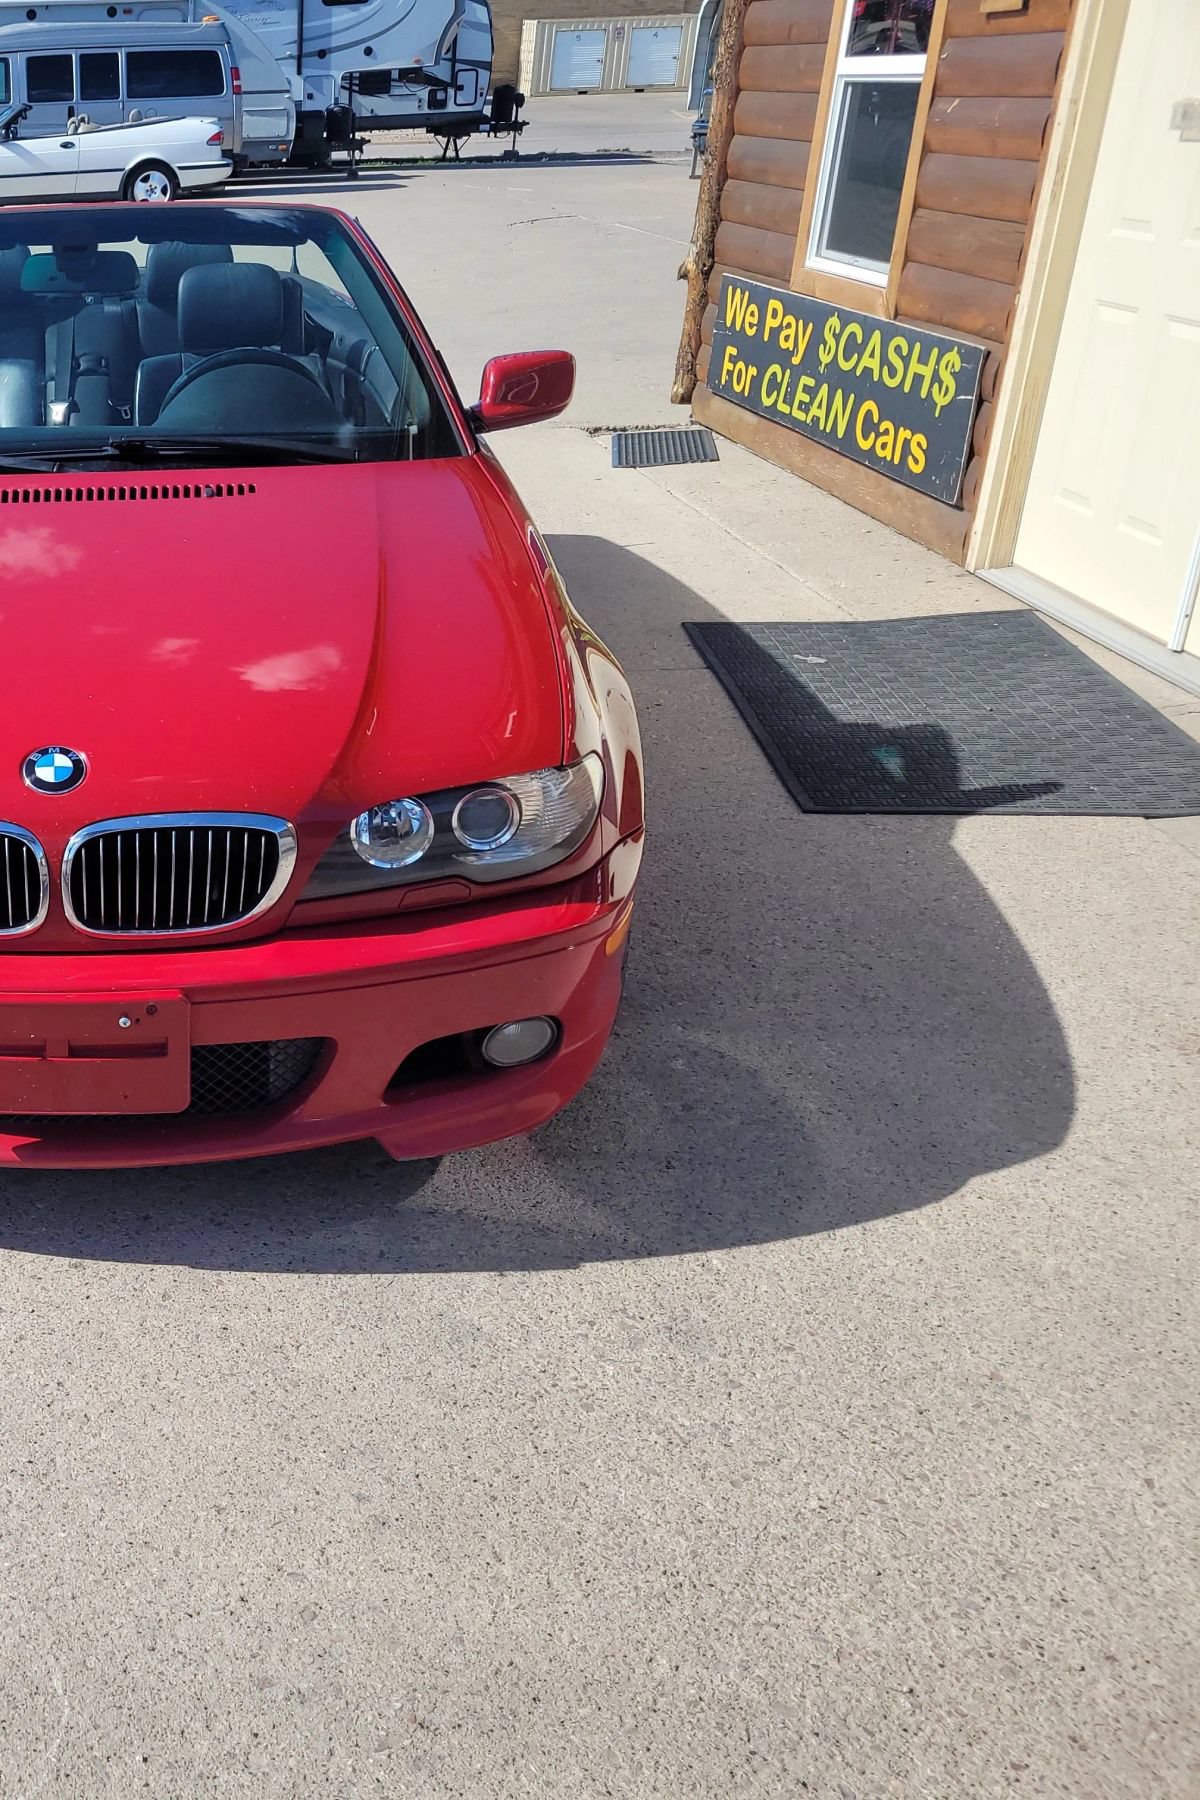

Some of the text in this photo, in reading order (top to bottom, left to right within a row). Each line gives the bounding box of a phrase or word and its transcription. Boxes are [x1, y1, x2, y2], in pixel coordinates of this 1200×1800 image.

[653, 31, 659, 39] 4
[724, 284, 962, 418] We Pay $CASH$
[720, 345, 928, 474] For CLEAN Cars
[30, 748, 80, 761] BMW
